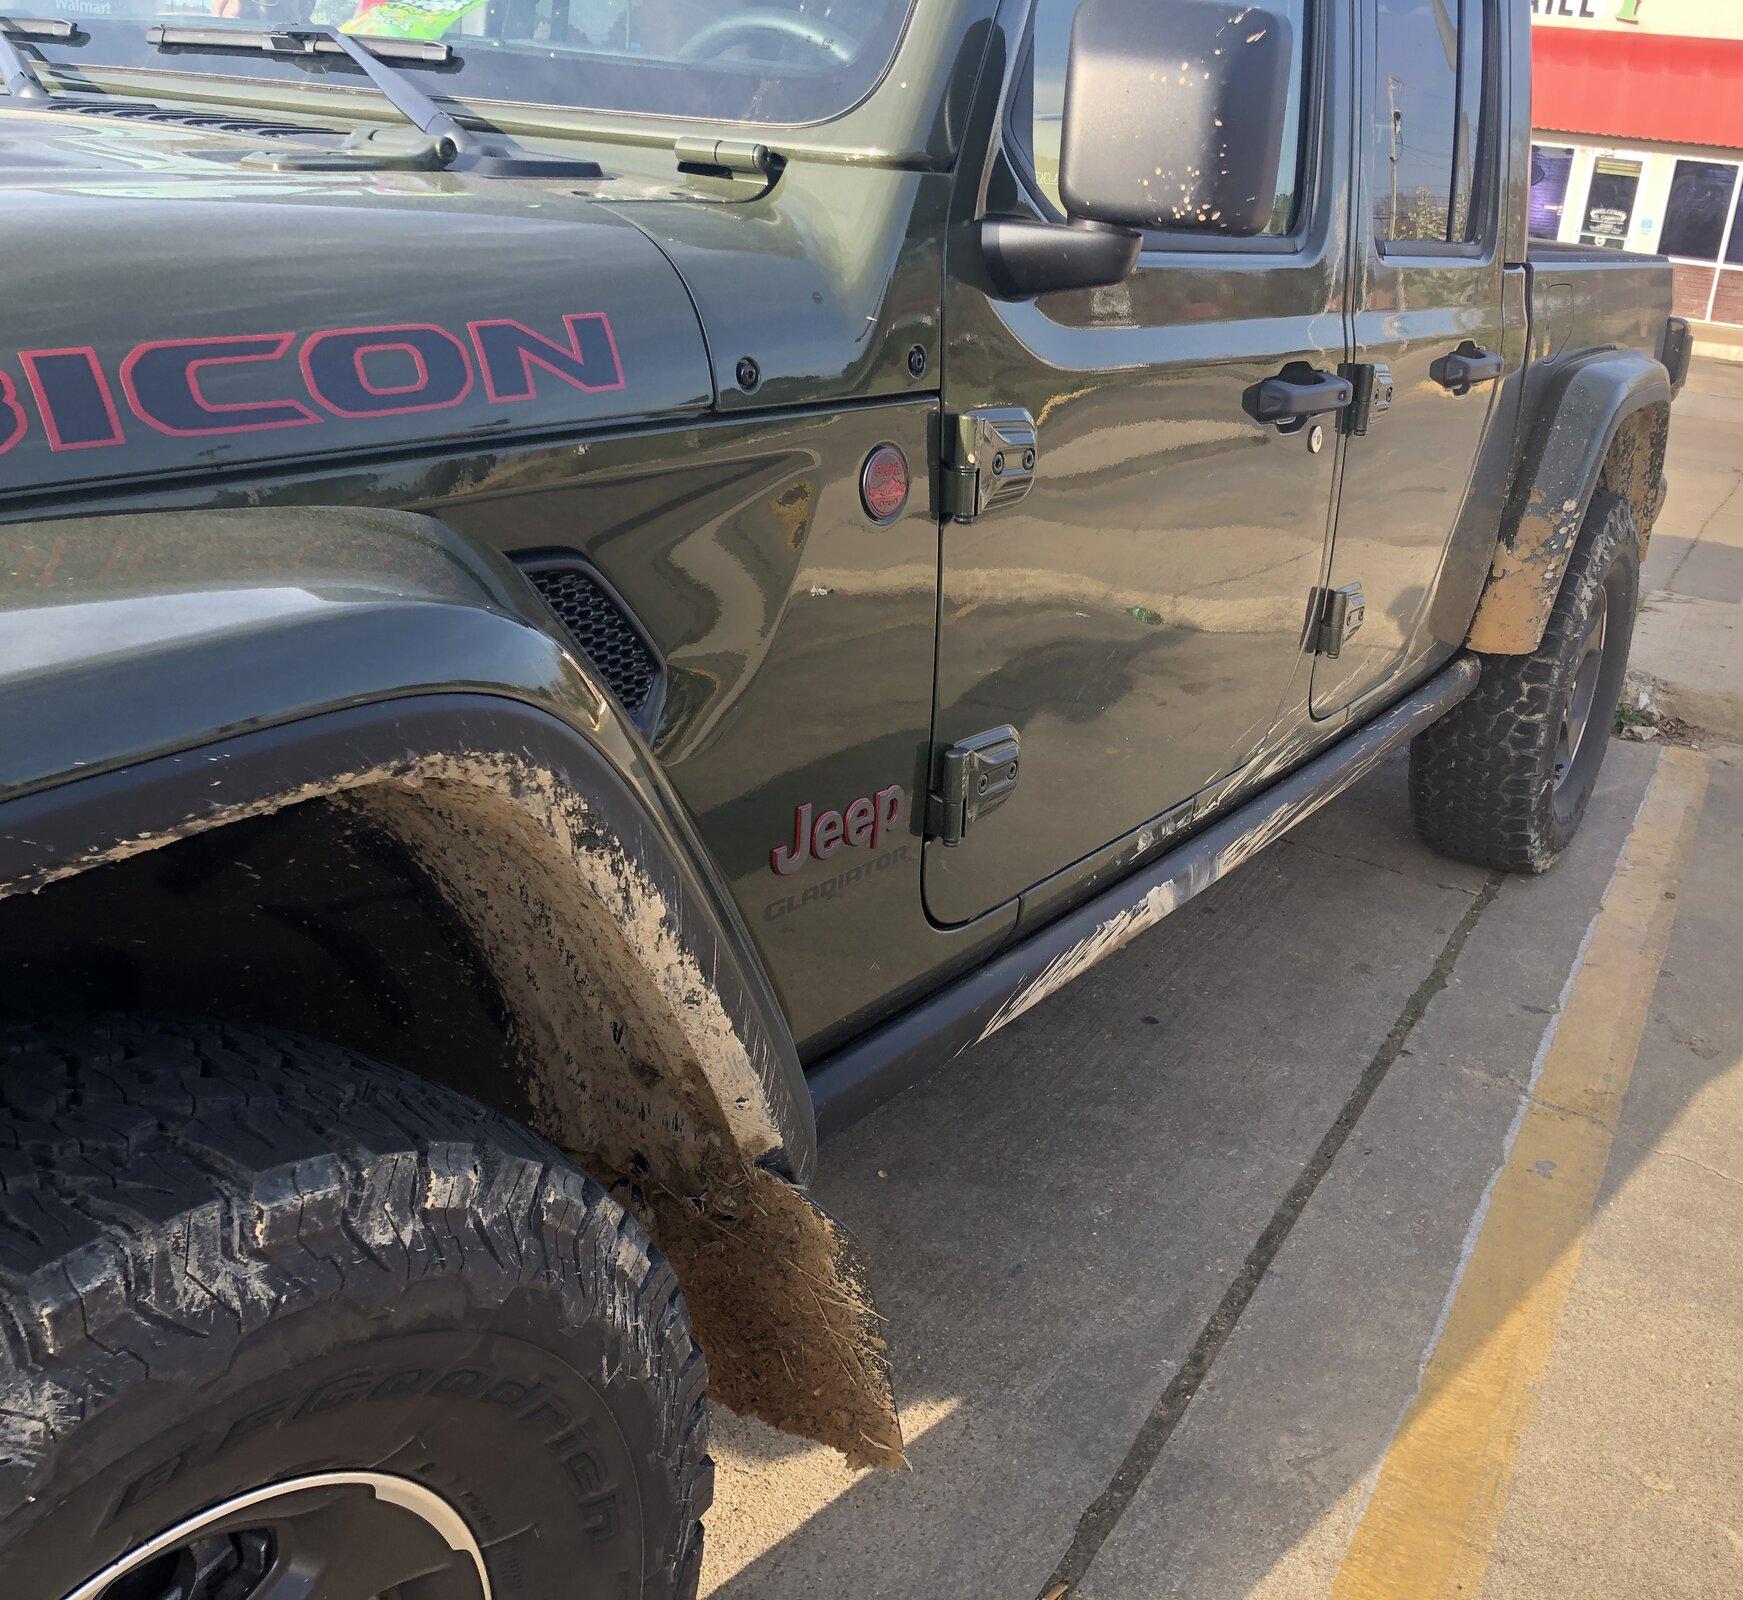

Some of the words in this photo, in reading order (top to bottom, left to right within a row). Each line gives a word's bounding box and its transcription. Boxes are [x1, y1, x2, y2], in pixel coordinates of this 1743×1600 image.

[55, 0, 111, 14] Walmart
[769, 784, 906, 876] Jeep
[763, 845, 912, 921] GLADIATOR
